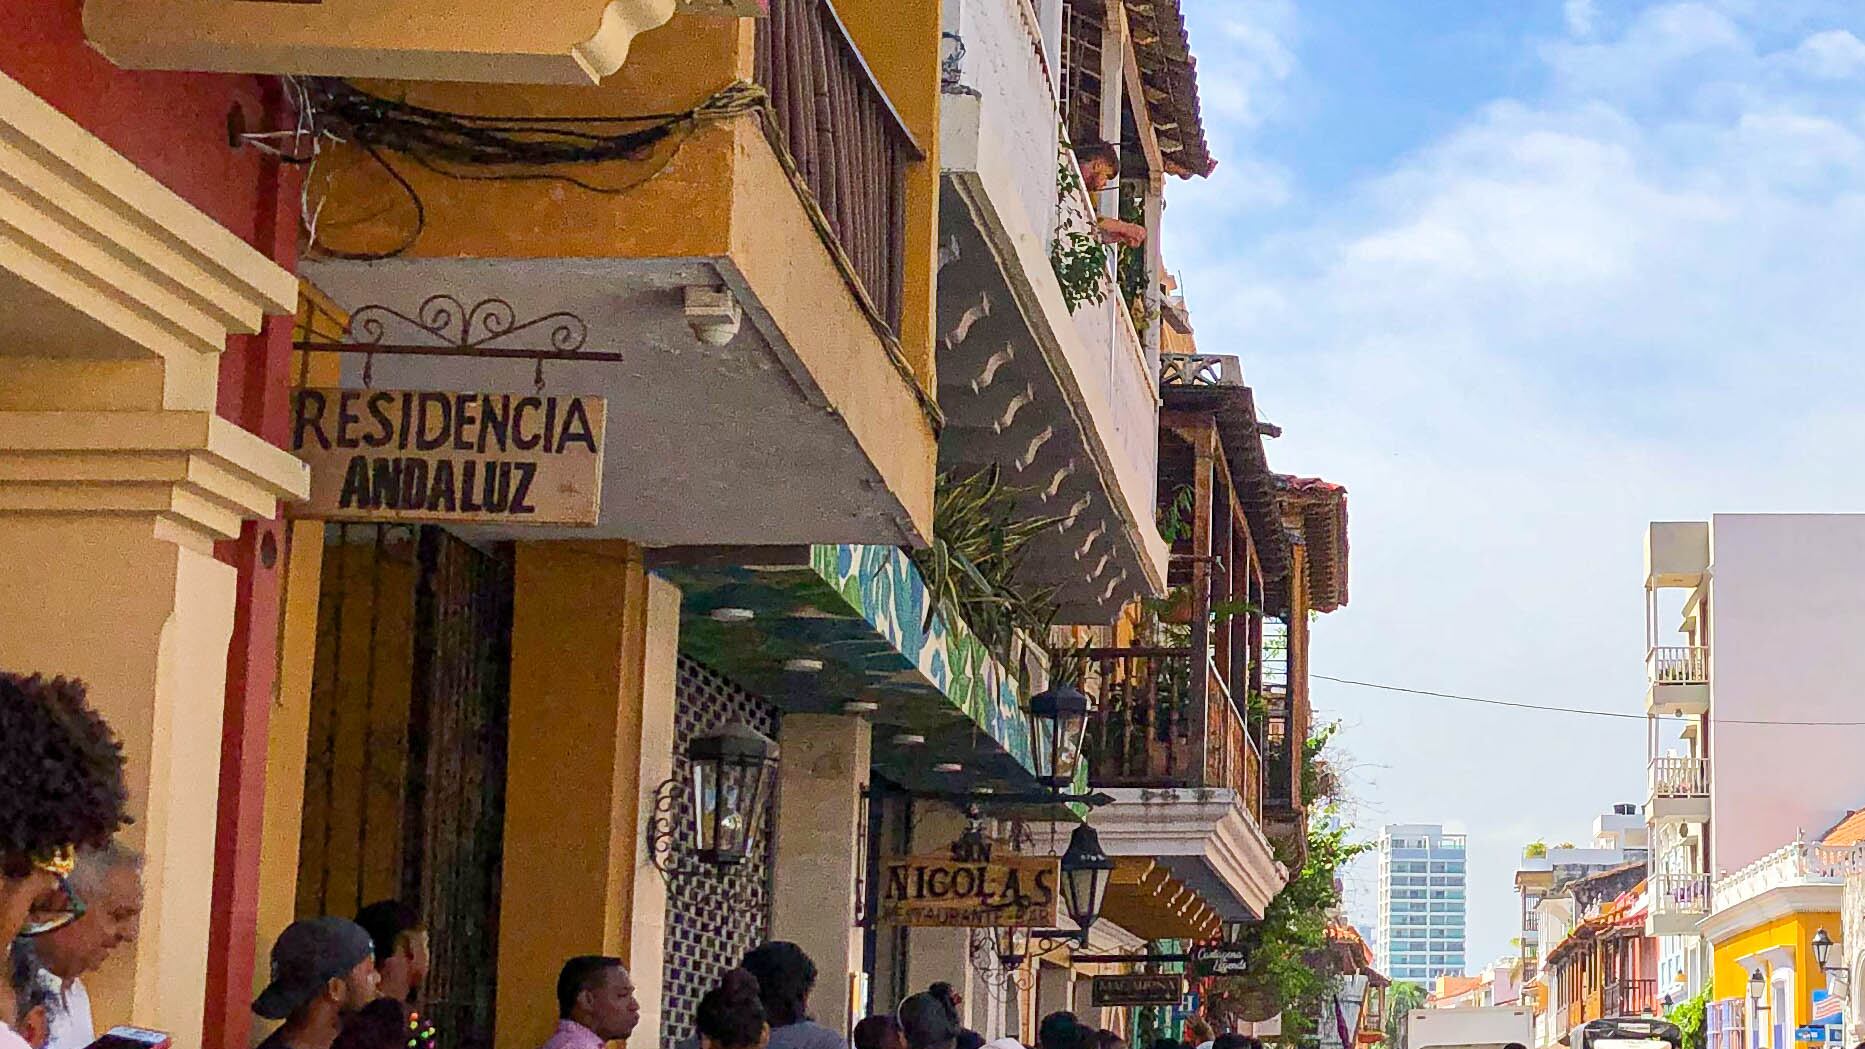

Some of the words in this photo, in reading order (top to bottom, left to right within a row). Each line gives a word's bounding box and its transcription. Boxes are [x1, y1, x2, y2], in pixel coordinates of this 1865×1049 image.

[292, 390, 598, 454] RESIDENCIA
[338, 455, 538, 515] ANDALUZ
[885, 864, 1054, 907] NICOLAS
[884, 905, 1003, 926] RESTAURANTE
